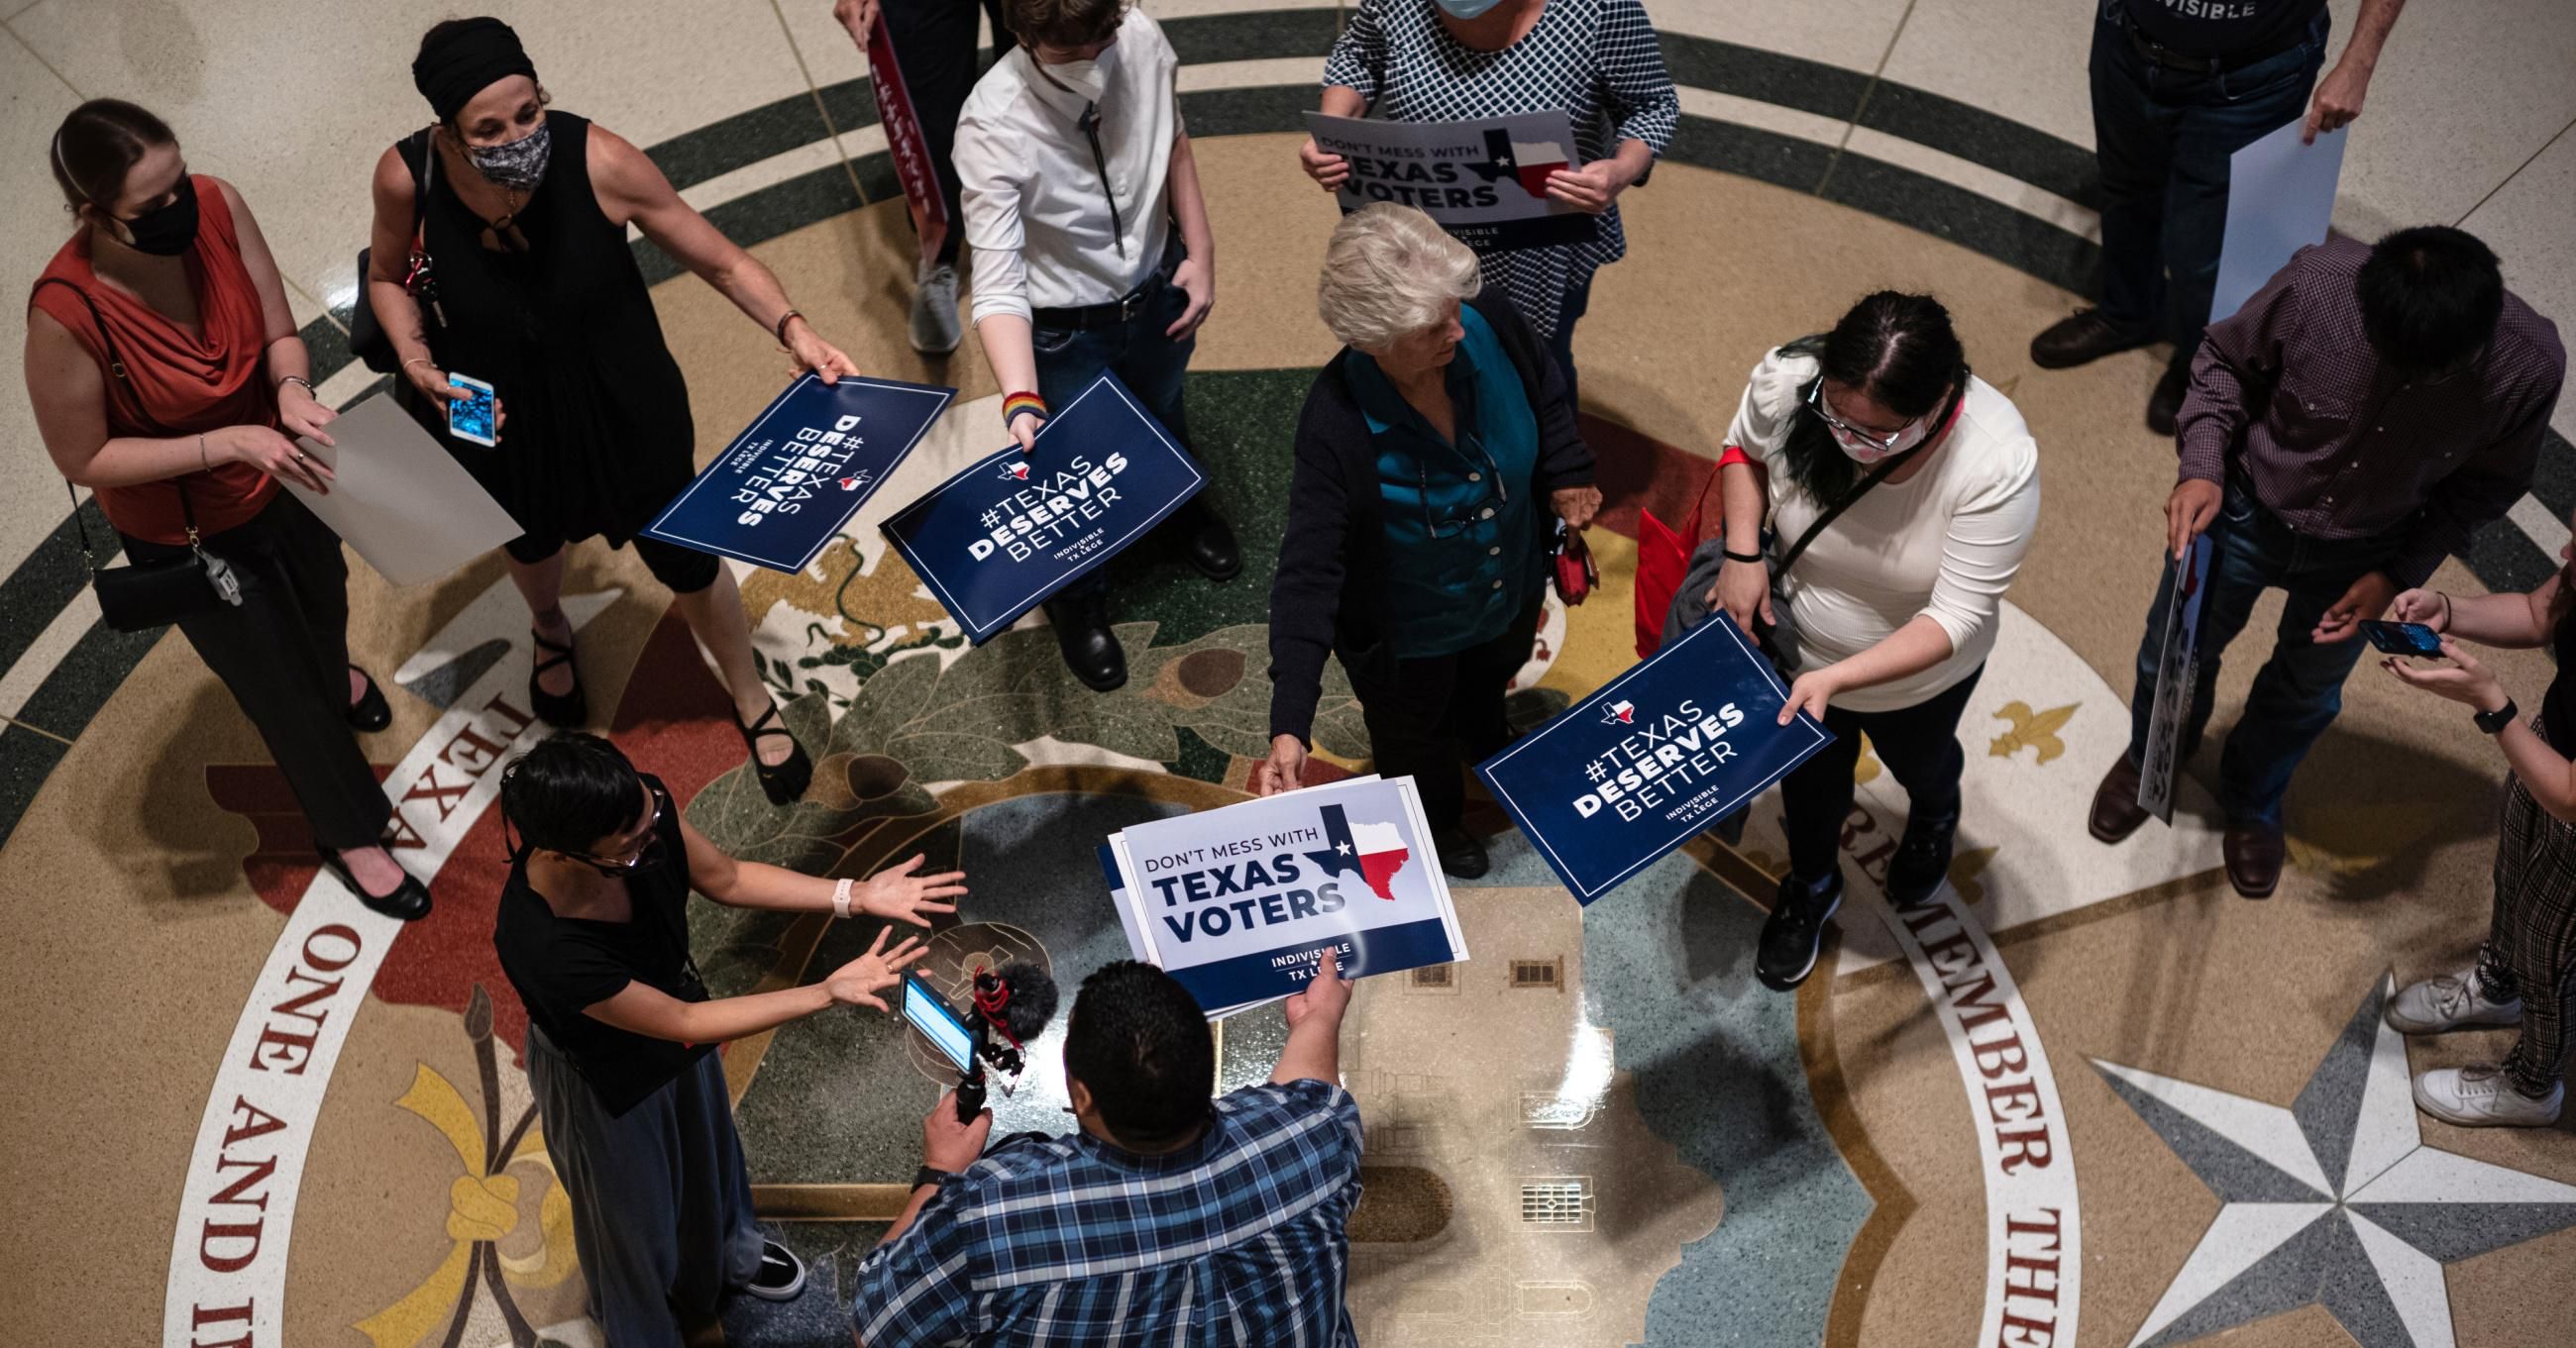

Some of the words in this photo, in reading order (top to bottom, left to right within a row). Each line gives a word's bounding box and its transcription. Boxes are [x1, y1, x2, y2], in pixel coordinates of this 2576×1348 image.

[1379, 146, 1426, 159] MESS
[1430, 145, 1479, 158] WITH
[1342, 179, 1499, 209] VOTERS
[1449, 227, 1499, 236] VISIBLE
[730, 427, 823, 504] BETTER
[737, 414, 862, 527] DESERVES
[778, 436, 864, 515] #TEXAS
[980, 455, 1092, 528] #TEXAS
[967, 451, 1128, 562] DESERVES
[1006, 486, 1123, 563] BETTER
[1053, 527, 1105, 560] INDIVISIBLE
[1067, 552, 1080, 563] TX
[1080, 538, 1104, 556] LEGE
[382, 691, 539, 850] TEXA
[1572, 702, 1745, 818] DESERVES
[1585, 699, 1703, 782] #TEXAS
[1614, 741, 1739, 823] BETTER
[1665, 784, 1719, 821] INDIVISIBLE
[1680, 810, 1694, 823] TX
[1694, 796, 1719, 816] LEGE
[1144, 847, 1206, 873] DON'T
[1212, 838, 1263, 860] MESS
[1267, 827, 1319, 849] WITH
[1151, 853, 1301, 907] TEXAS
[1161, 882, 1345, 944] VOTERS
[1271, 942, 1350, 968] INDIVISLE
[1288, 970, 1307, 982] TX
[1309, 961, 1344, 978] LE
[249, 923, 363, 1076] ONE
[200, 1094, 287, 1273] AND
[1997, 1207, 2061, 1348] THE
